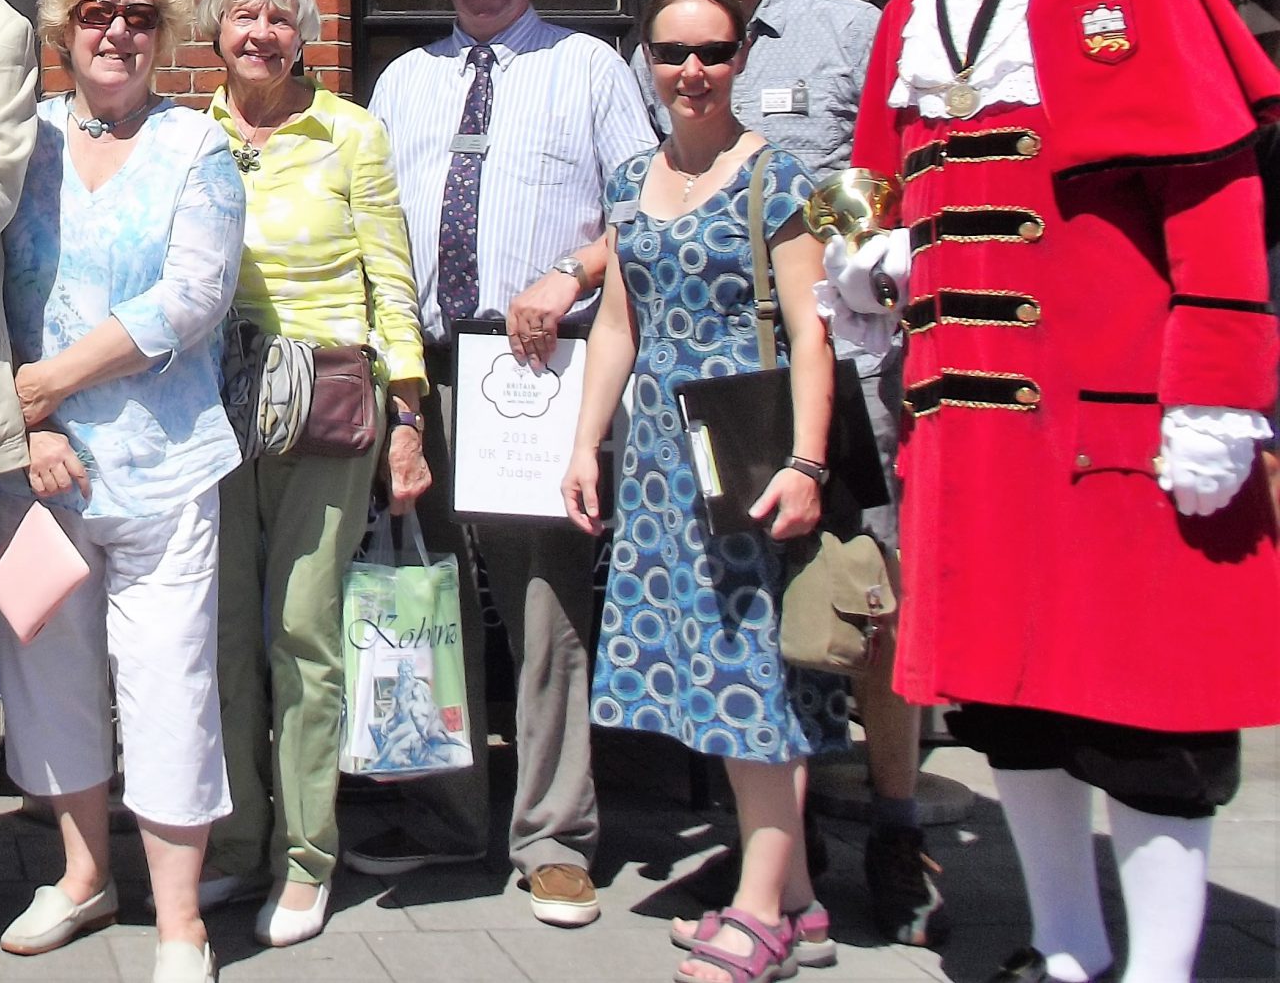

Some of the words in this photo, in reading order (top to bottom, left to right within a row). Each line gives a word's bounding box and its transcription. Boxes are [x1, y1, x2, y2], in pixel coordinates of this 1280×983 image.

[501, 431, 538, 444] 2018
[478, 448, 496, 460] UK
[506, 449, 561, 463] Finals
[496, 467, 543, 481] Judge
